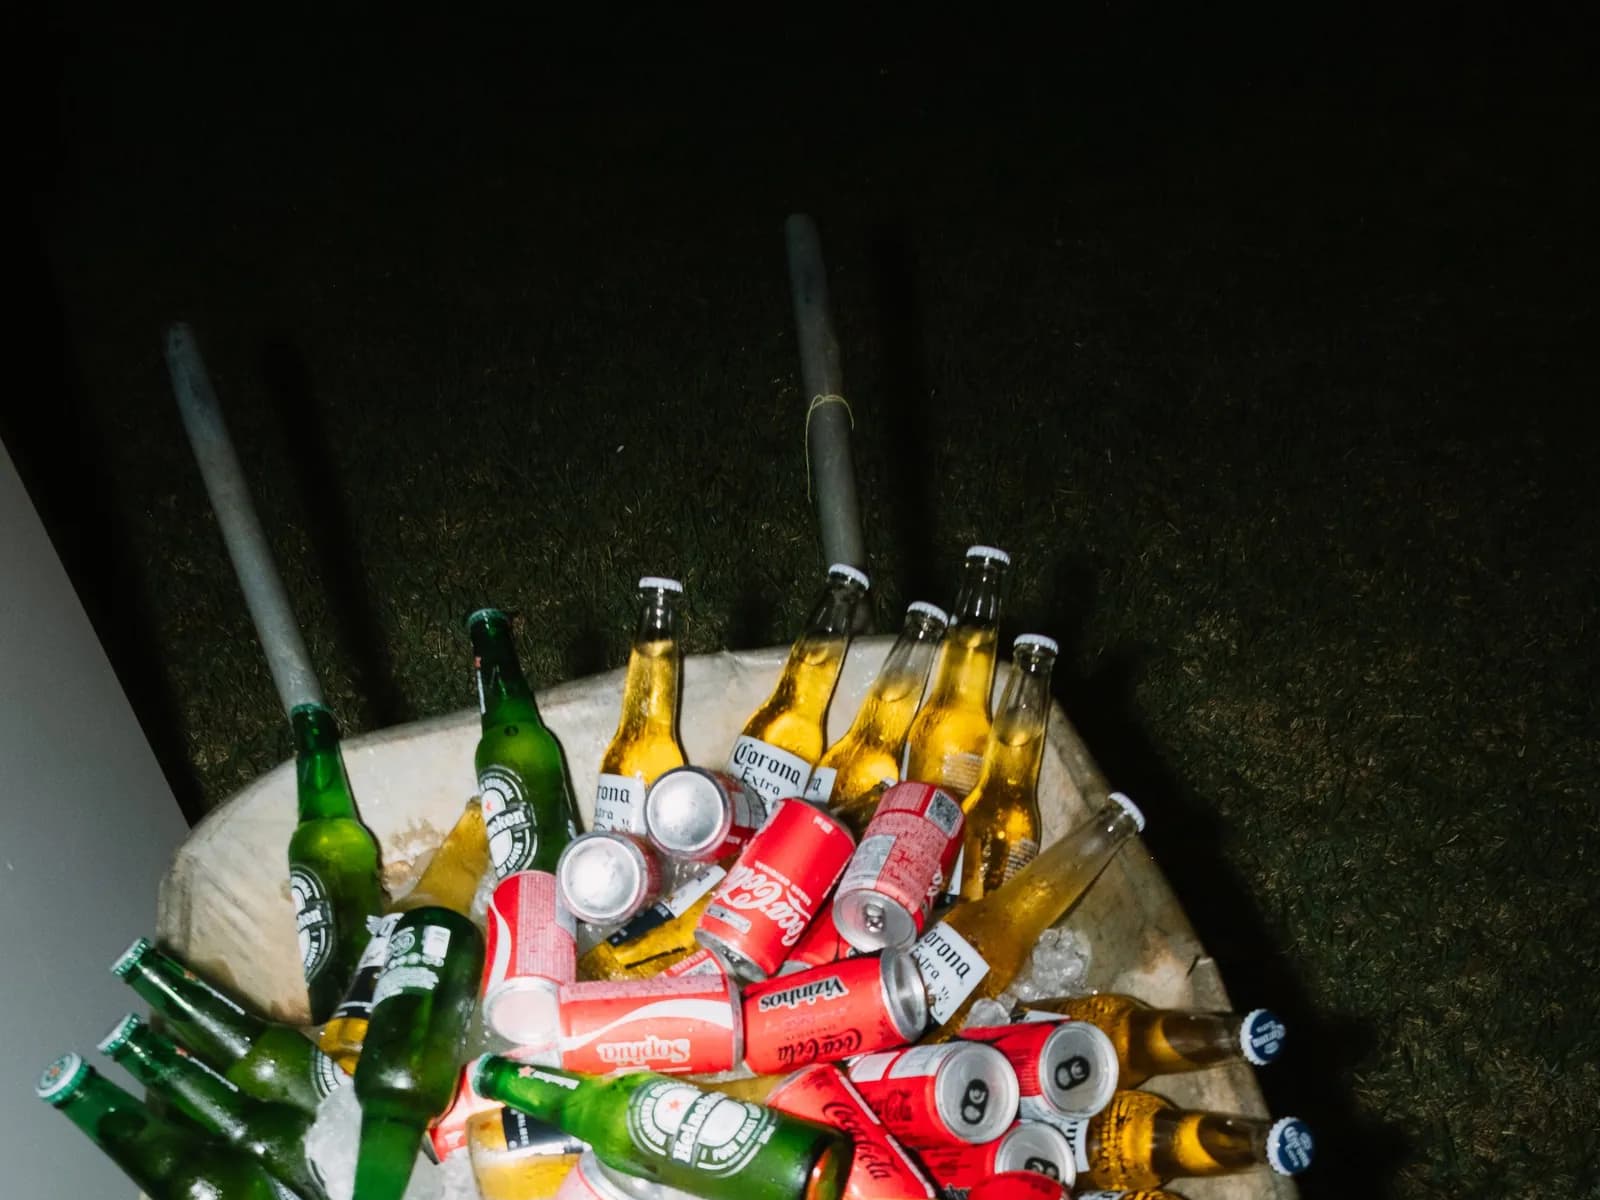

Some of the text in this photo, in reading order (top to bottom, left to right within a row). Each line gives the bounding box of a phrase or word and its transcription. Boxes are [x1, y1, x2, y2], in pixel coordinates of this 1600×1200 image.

[733, 738, 801, 786] Corona
[741, 767, 781, 796] Extra
[596, 784, 630, 804] rona
[714, 865, 808, 947] Coca-Cola
[924, 930, 971, 980] orona
[759, 975, 847, 1011] Vizinhos
[777, 1027, 863, 1067] Coca-Cola
